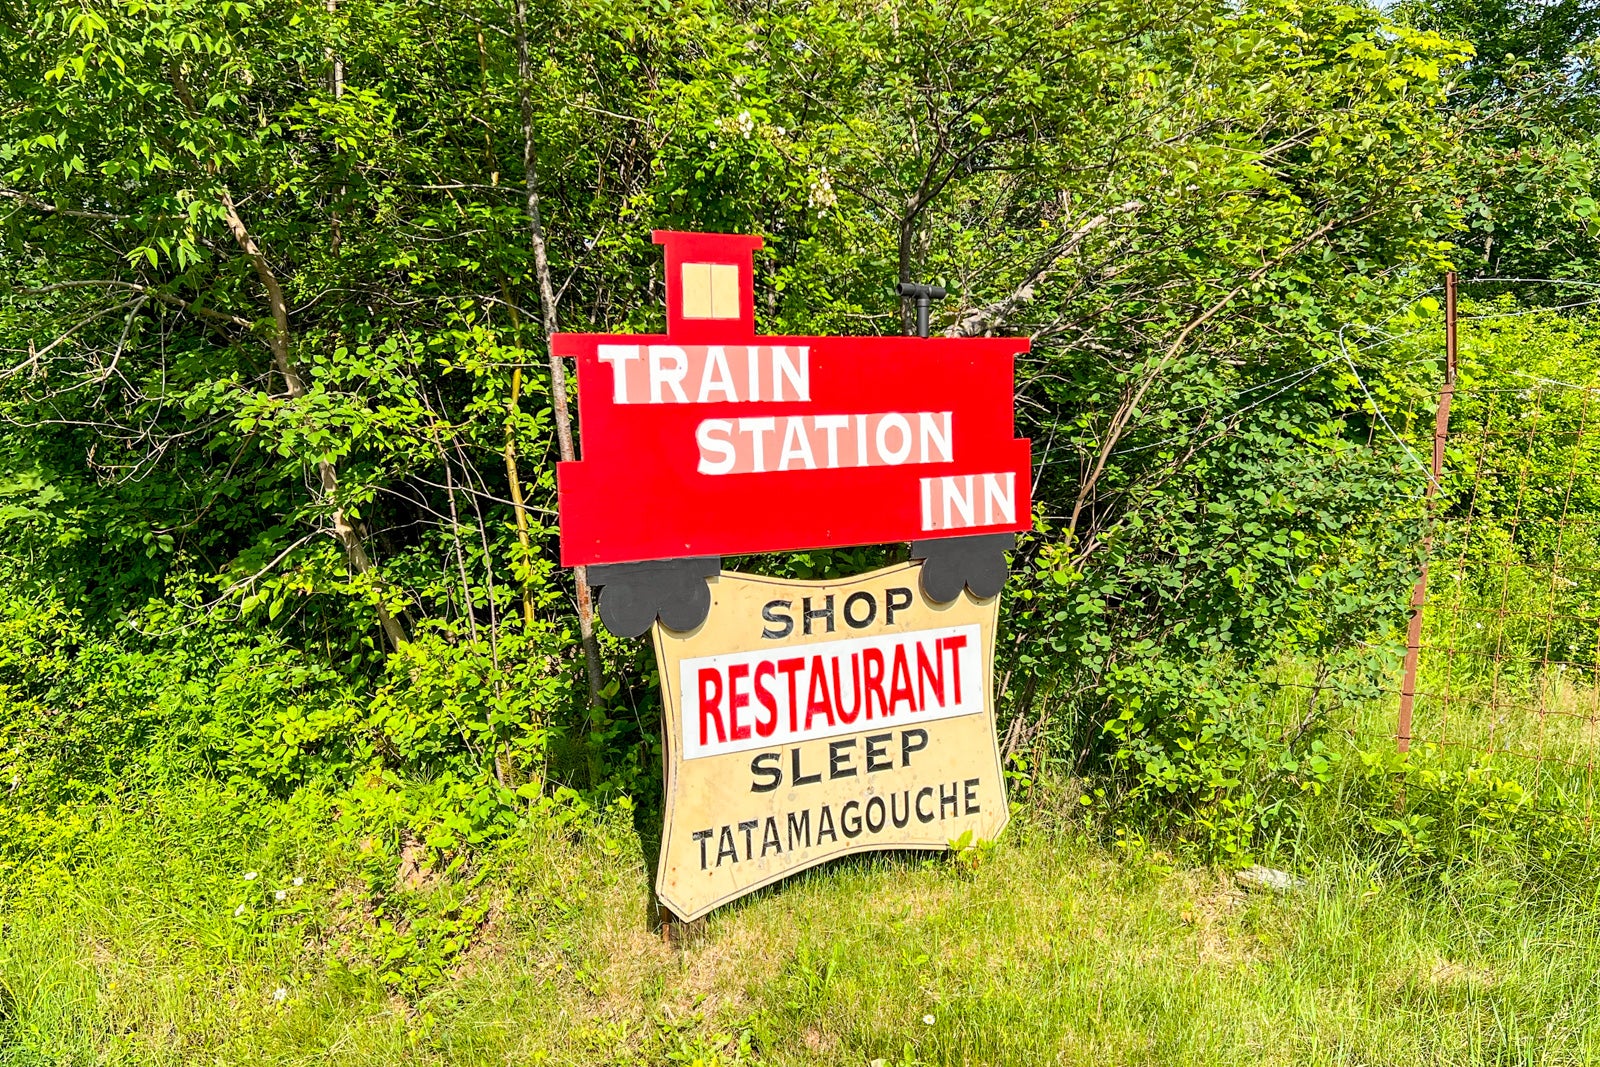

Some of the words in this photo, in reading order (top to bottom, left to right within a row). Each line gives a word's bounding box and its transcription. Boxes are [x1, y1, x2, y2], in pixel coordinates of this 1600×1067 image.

[597, 344, 811, 404] TRAIN
[696, 411, 953, 475] STATION
[920, 472, 1016, 531] INN
[761, 586, 913, 639] SHOP
[698, 634, 968, 746] RESTAURANT
[750, 728, 929, 793] SLEEP
[692, 778, 981, 871] TATAMAGOUCHE
